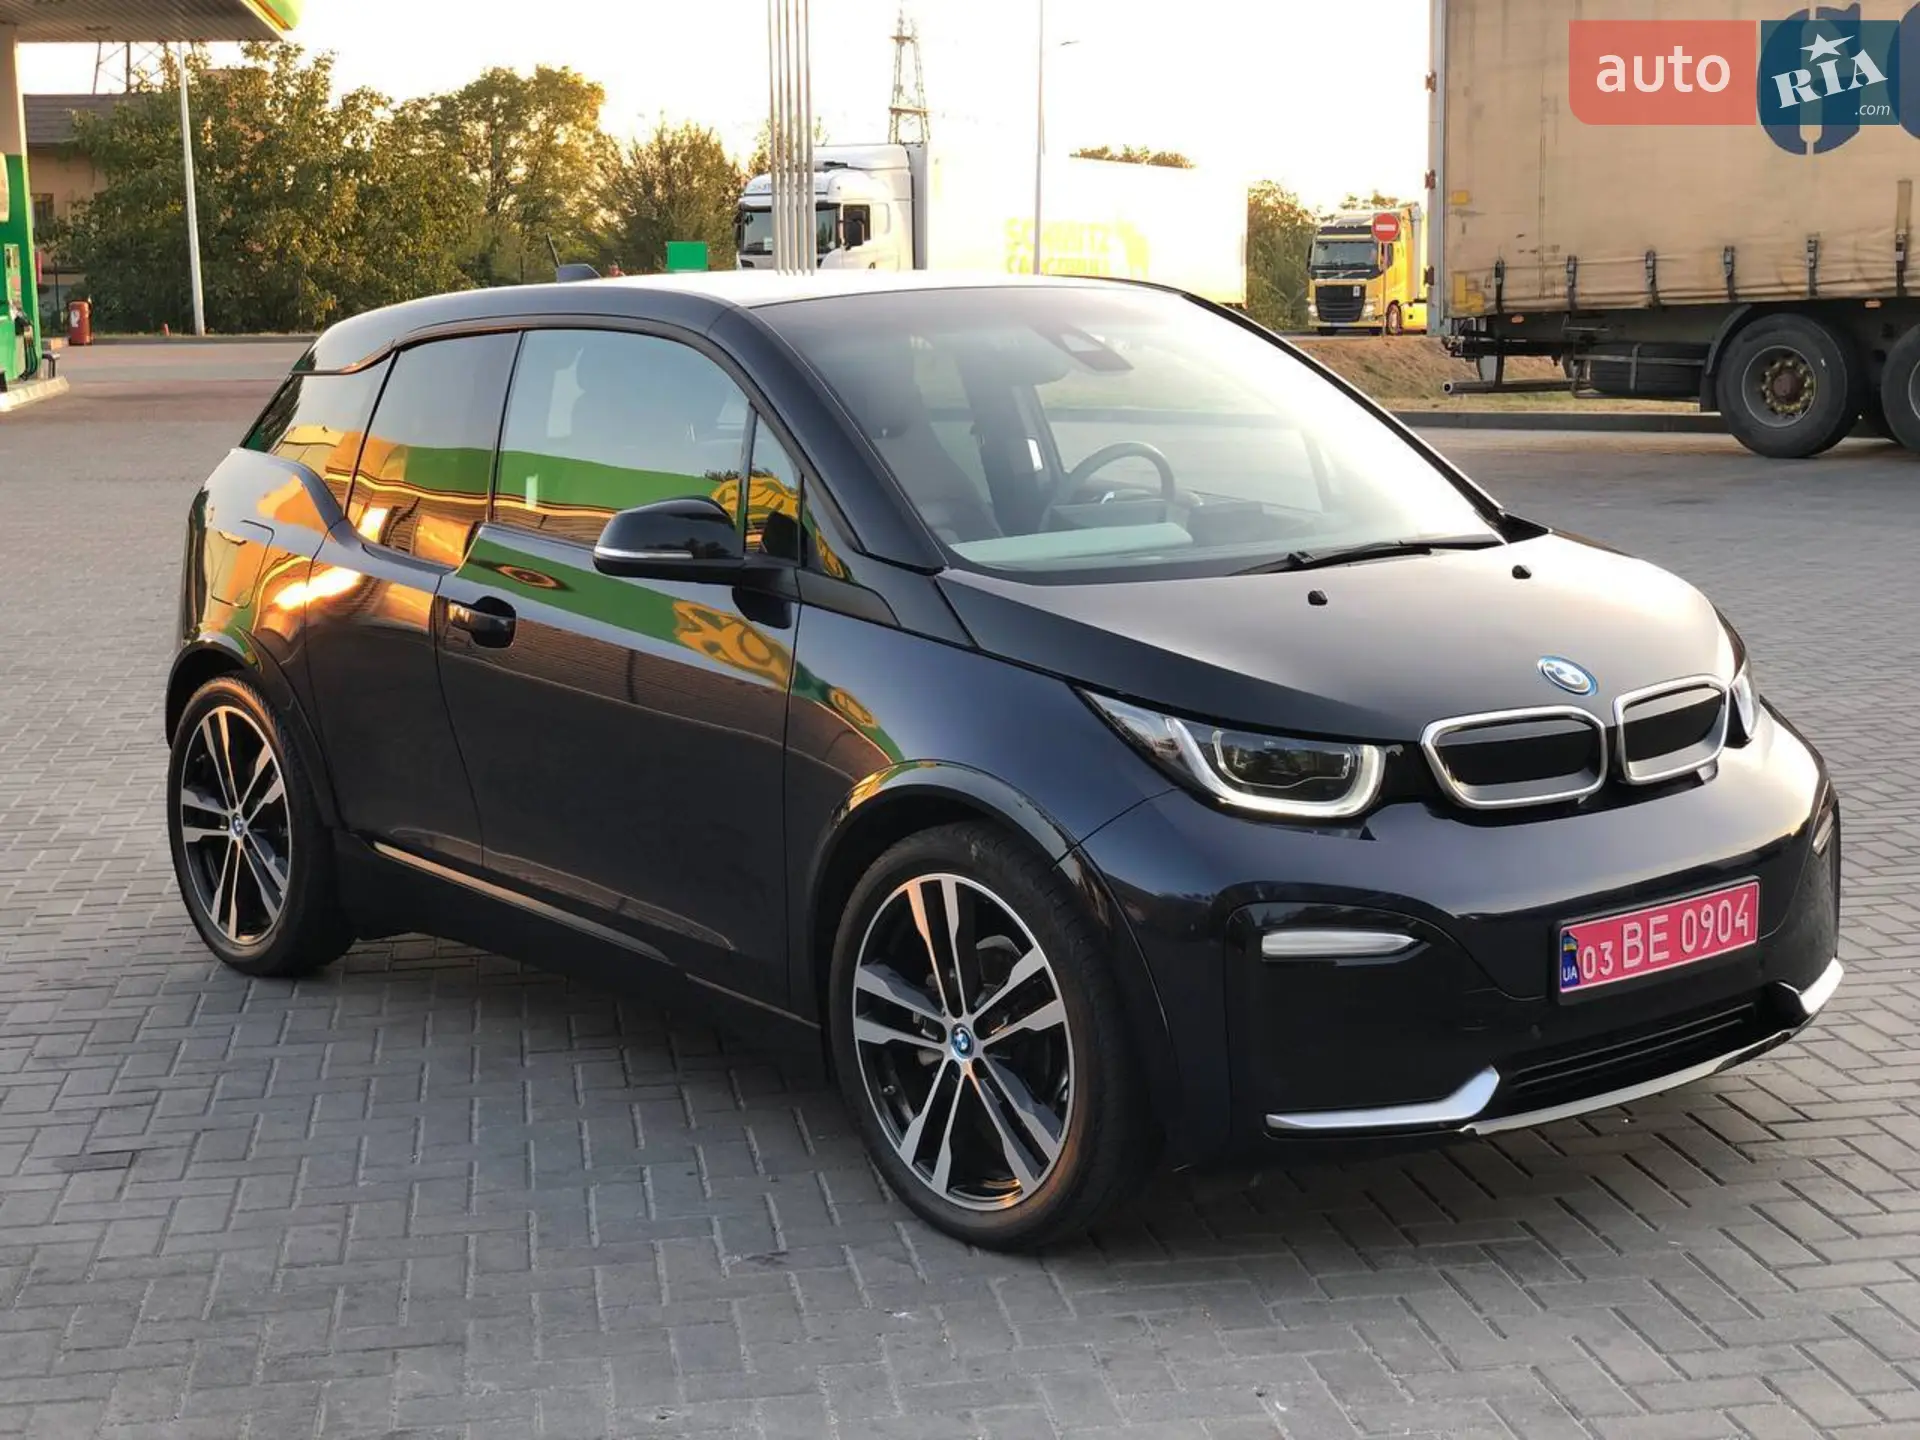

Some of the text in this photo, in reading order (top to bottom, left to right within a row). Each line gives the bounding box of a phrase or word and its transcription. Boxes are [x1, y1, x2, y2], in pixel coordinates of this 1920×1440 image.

[1583, 893, 1749, 979] 03 BE 0904
[1562, 966, 1578, 982] UA
